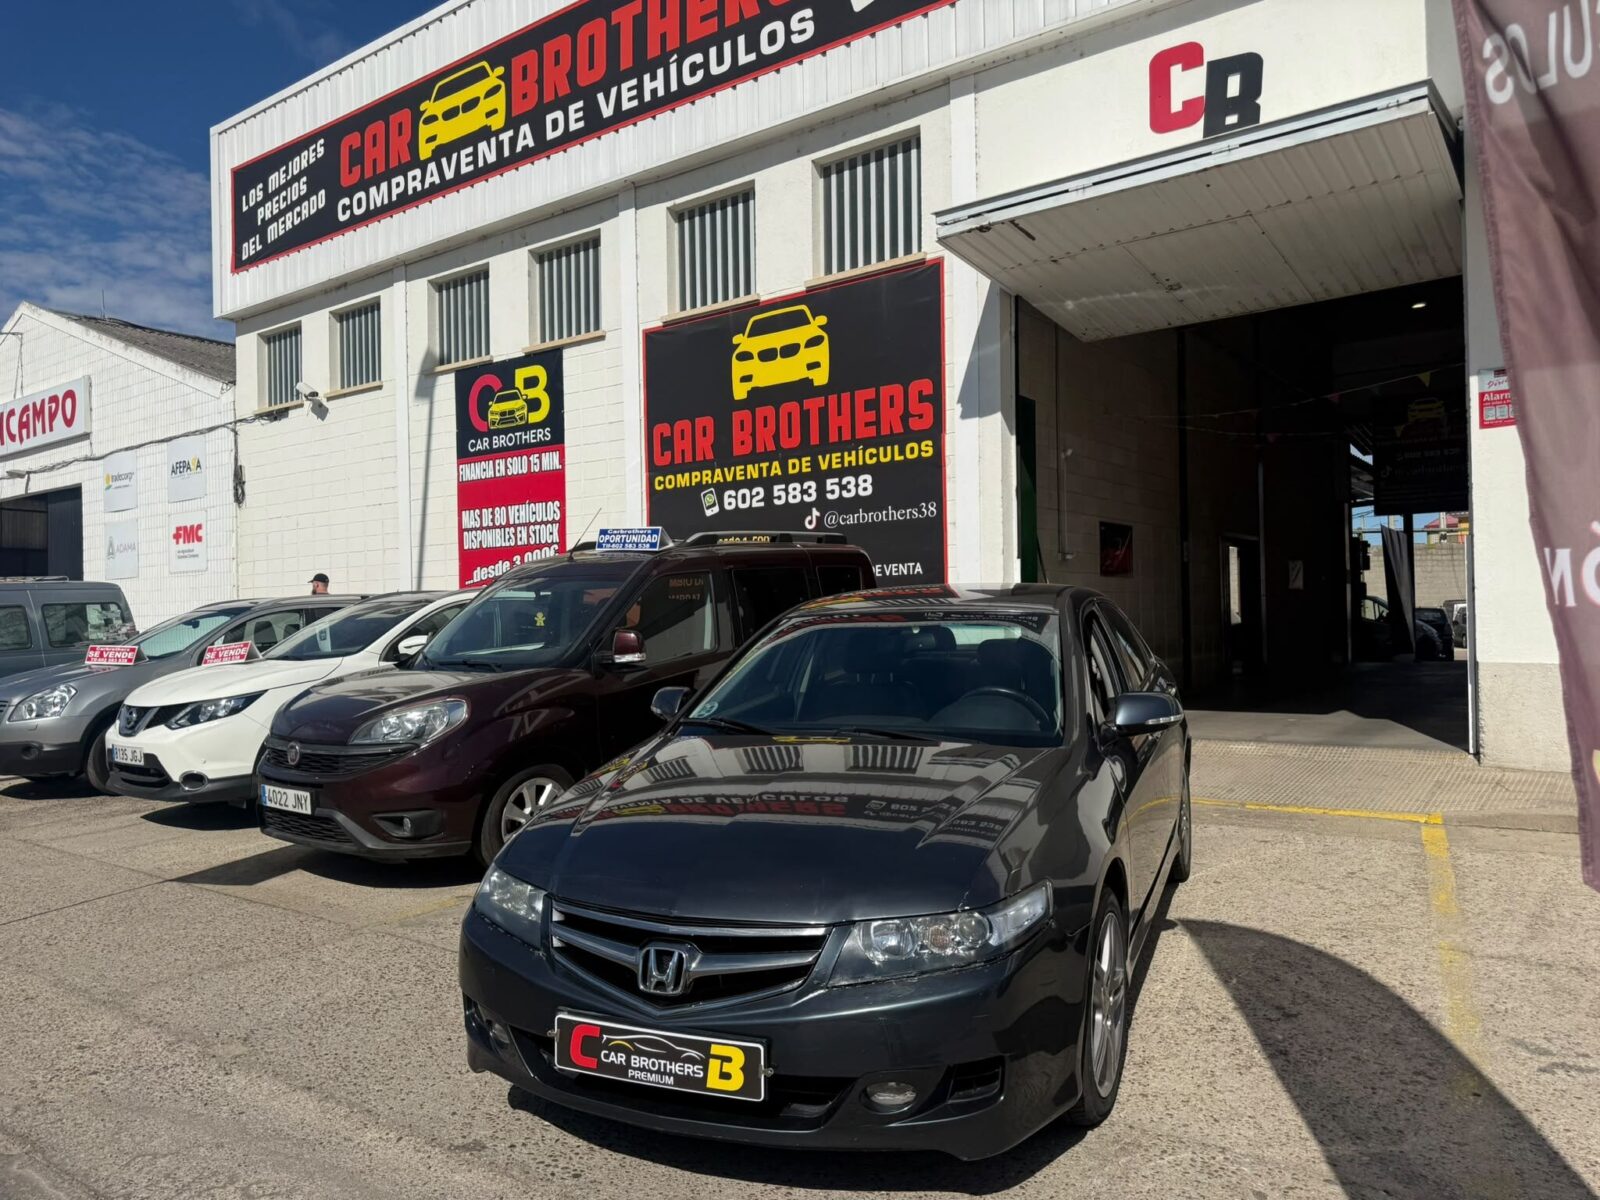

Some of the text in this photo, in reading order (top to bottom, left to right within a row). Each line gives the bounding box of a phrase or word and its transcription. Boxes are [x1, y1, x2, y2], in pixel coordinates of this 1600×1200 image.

[339, 0, 790, 188] CAR BROTHE
[337, 8, 815, 222] COMPRAVENTA DE VEHÍCULOS
[242, 138, 325, 212] LOS MEJORES
[257, 176, 308, 226] PRECIOS
[242, 188, 326, 261] DEL MERCADO
[653, 378, 934, 466] CAR BROTHERS
[468, 427, 551, 452] CAR BROTHERS
[459, 451, 562, 482] FINANCIA EN SOLO 15 MIN.
[654, 440, 934, 491] COMPRAVENTA DE VEHÍCULOS
[723, 474, 873, 510] 602 583 538
[462, 500, 560, 529] MAS DE 80 VEHÍCULOS
[824, 501, 937, 528] @carbrothers38
[173, 523, 203, 546] FMC
[463, 523, 559, 550] DISPONIBLES EN STOCK
[599, 534, 658, 543] OPORTUNIDAD
[883, 562, 923, 576] VENTA
[103, 651, 135, 659] VENDE
[206, 647, 248, 659] SE VENDE
[267, 788, 308, 811] 4022 JNY
[601, 1050, 626, 1066] CAR
[630, 1055, 704, 1078] BROTHERS
[628, 1069, 674, 1085] PREMIUM
